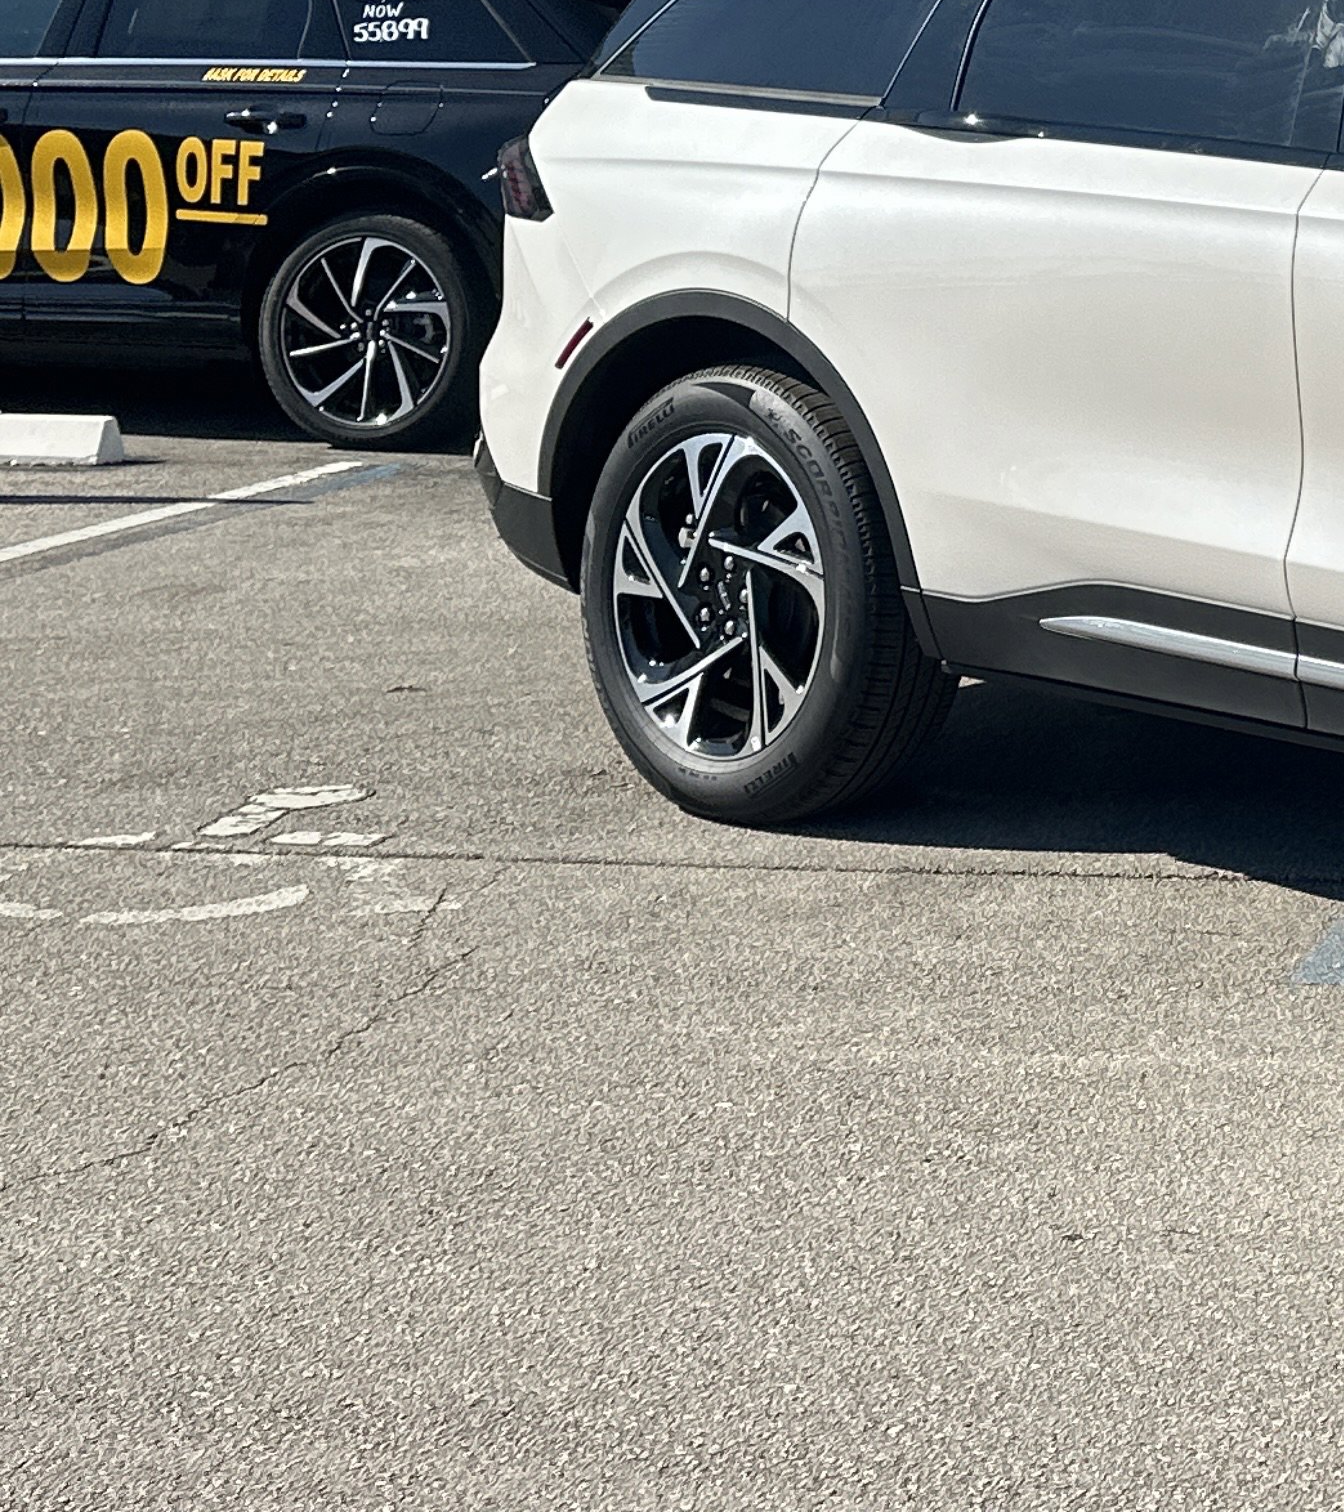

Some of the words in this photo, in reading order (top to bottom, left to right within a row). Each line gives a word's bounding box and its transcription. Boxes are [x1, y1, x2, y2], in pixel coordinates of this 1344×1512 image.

[362, 1, 404, 18] NOW
[256, 68, 307, 83] DETAILS
[176, 136, 265, 206] OFF
